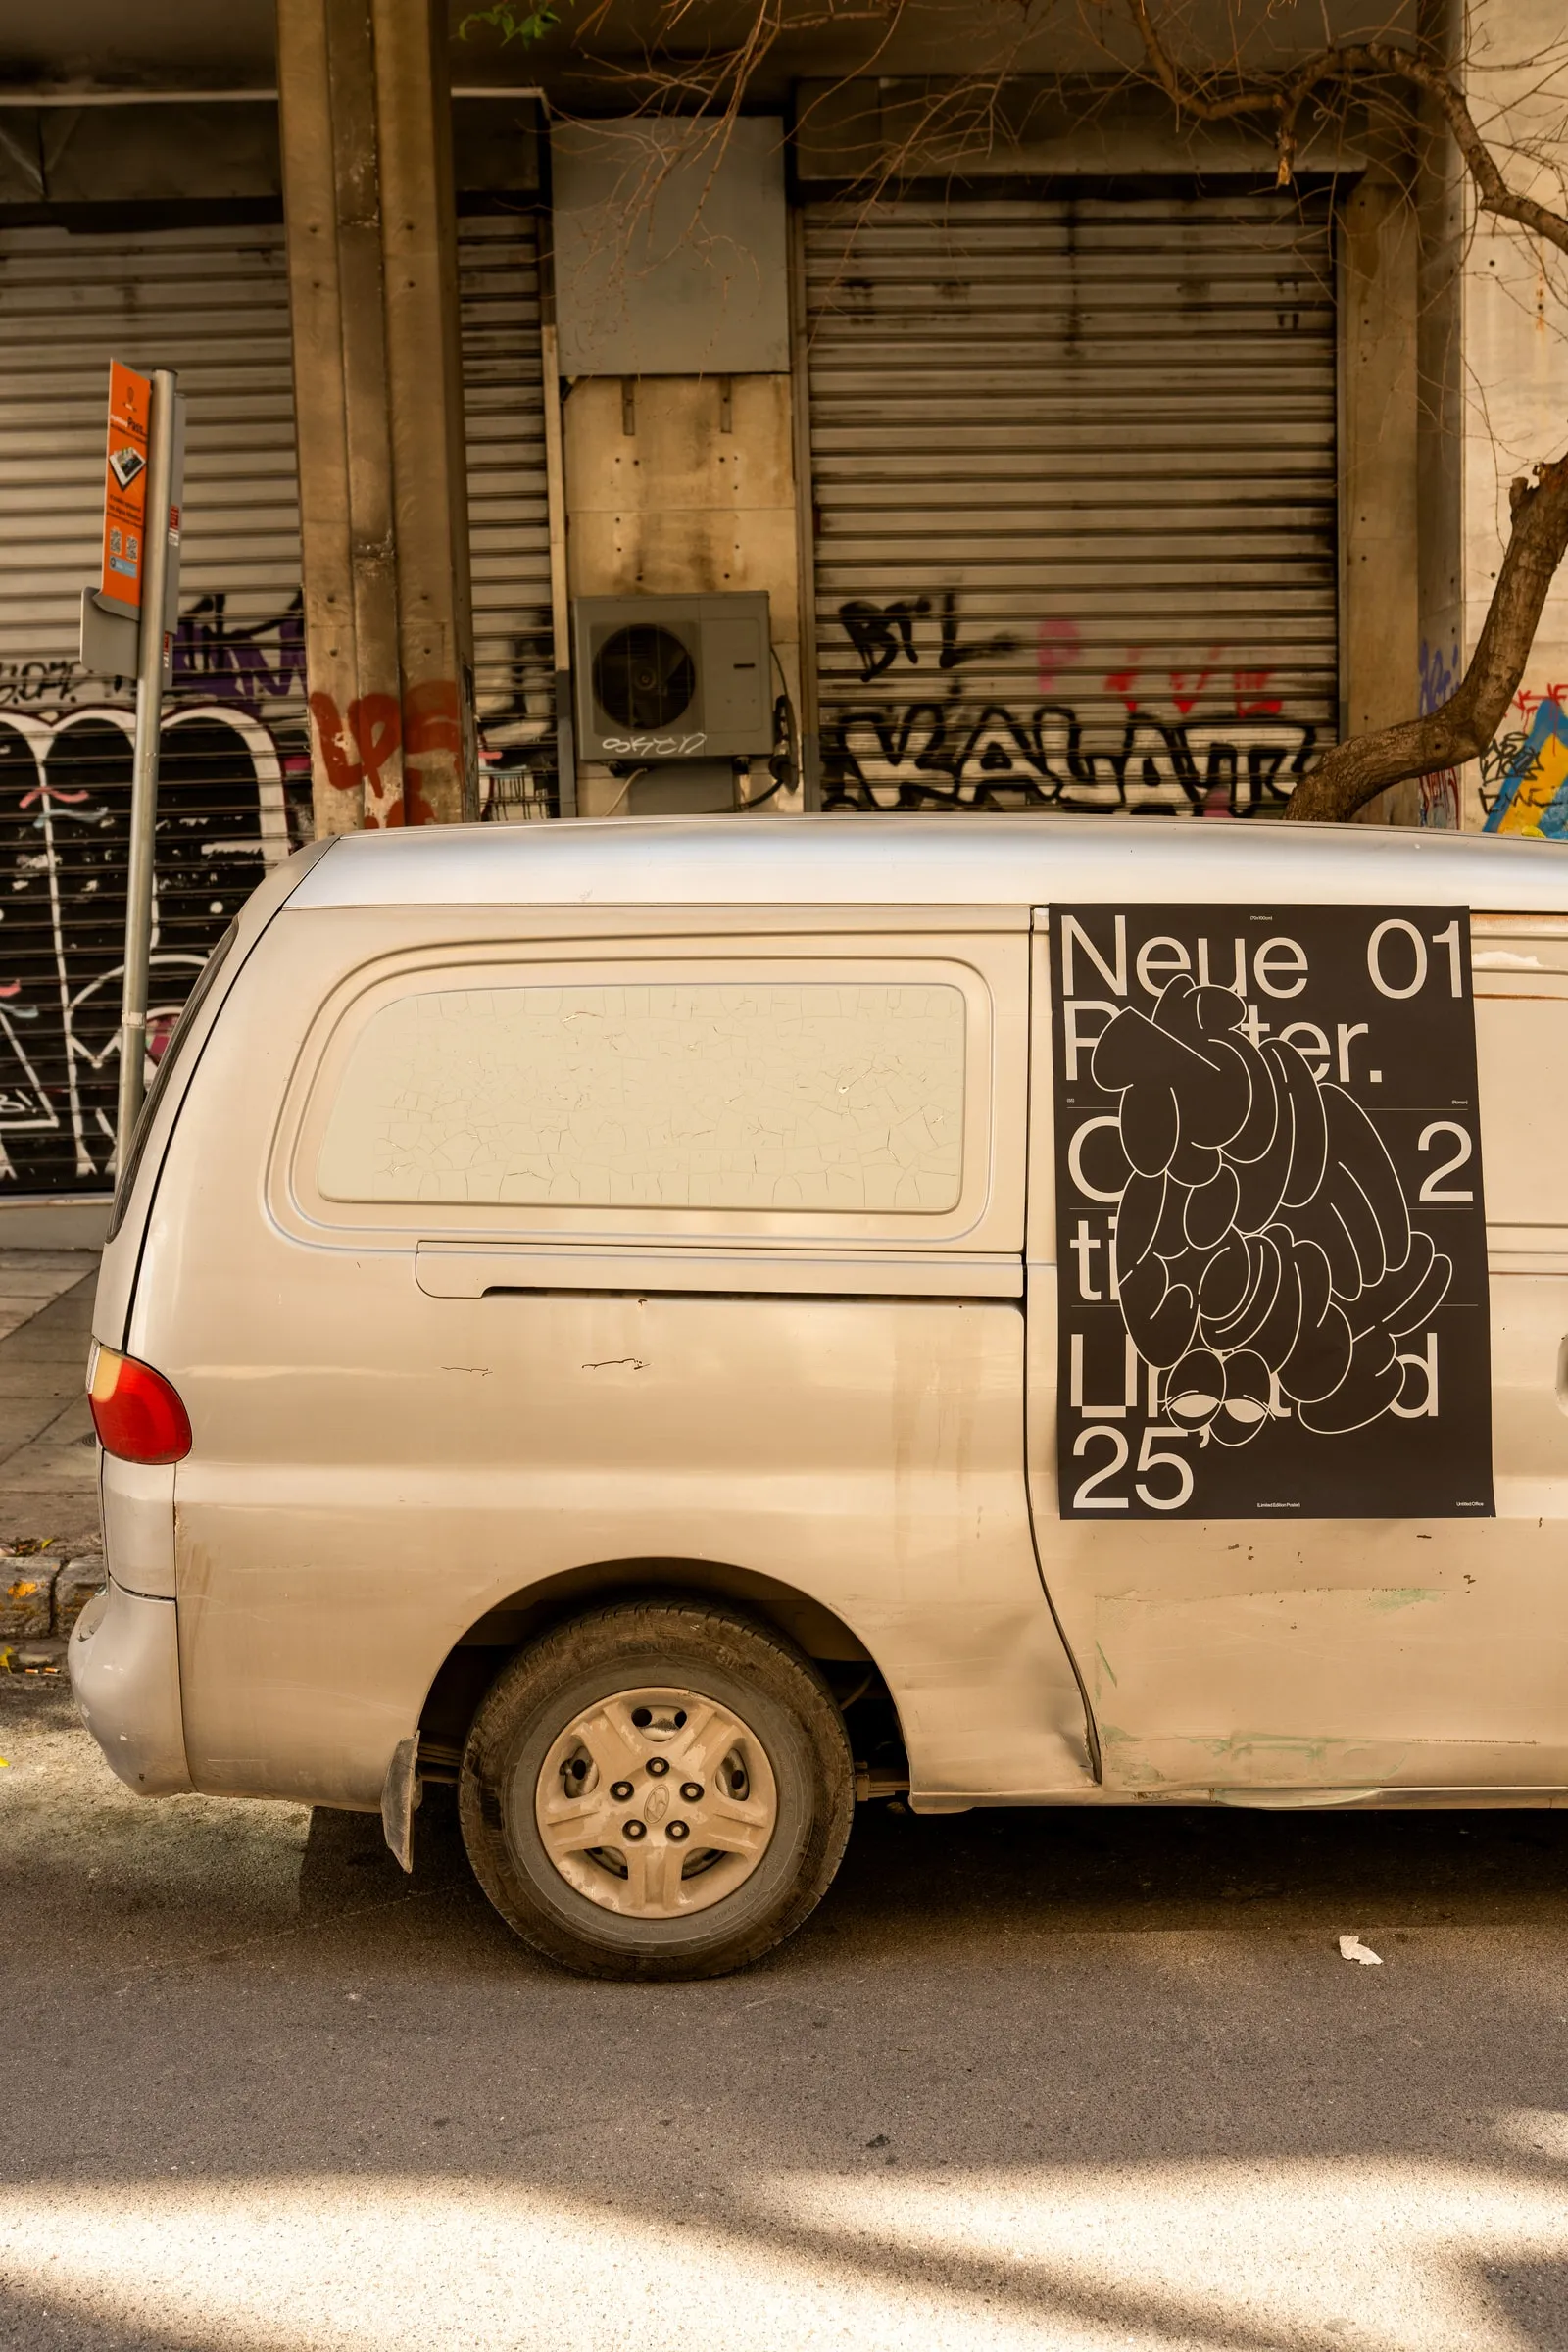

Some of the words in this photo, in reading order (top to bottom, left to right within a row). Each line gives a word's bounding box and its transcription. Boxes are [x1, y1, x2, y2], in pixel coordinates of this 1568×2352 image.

[1061, 915, 1309, 998] Neue
[1367, 919, 1463, 999] 01
[1064, 1001, 1383, 1083] Pter.
[1418, 1121, 1474, 1201] 2
